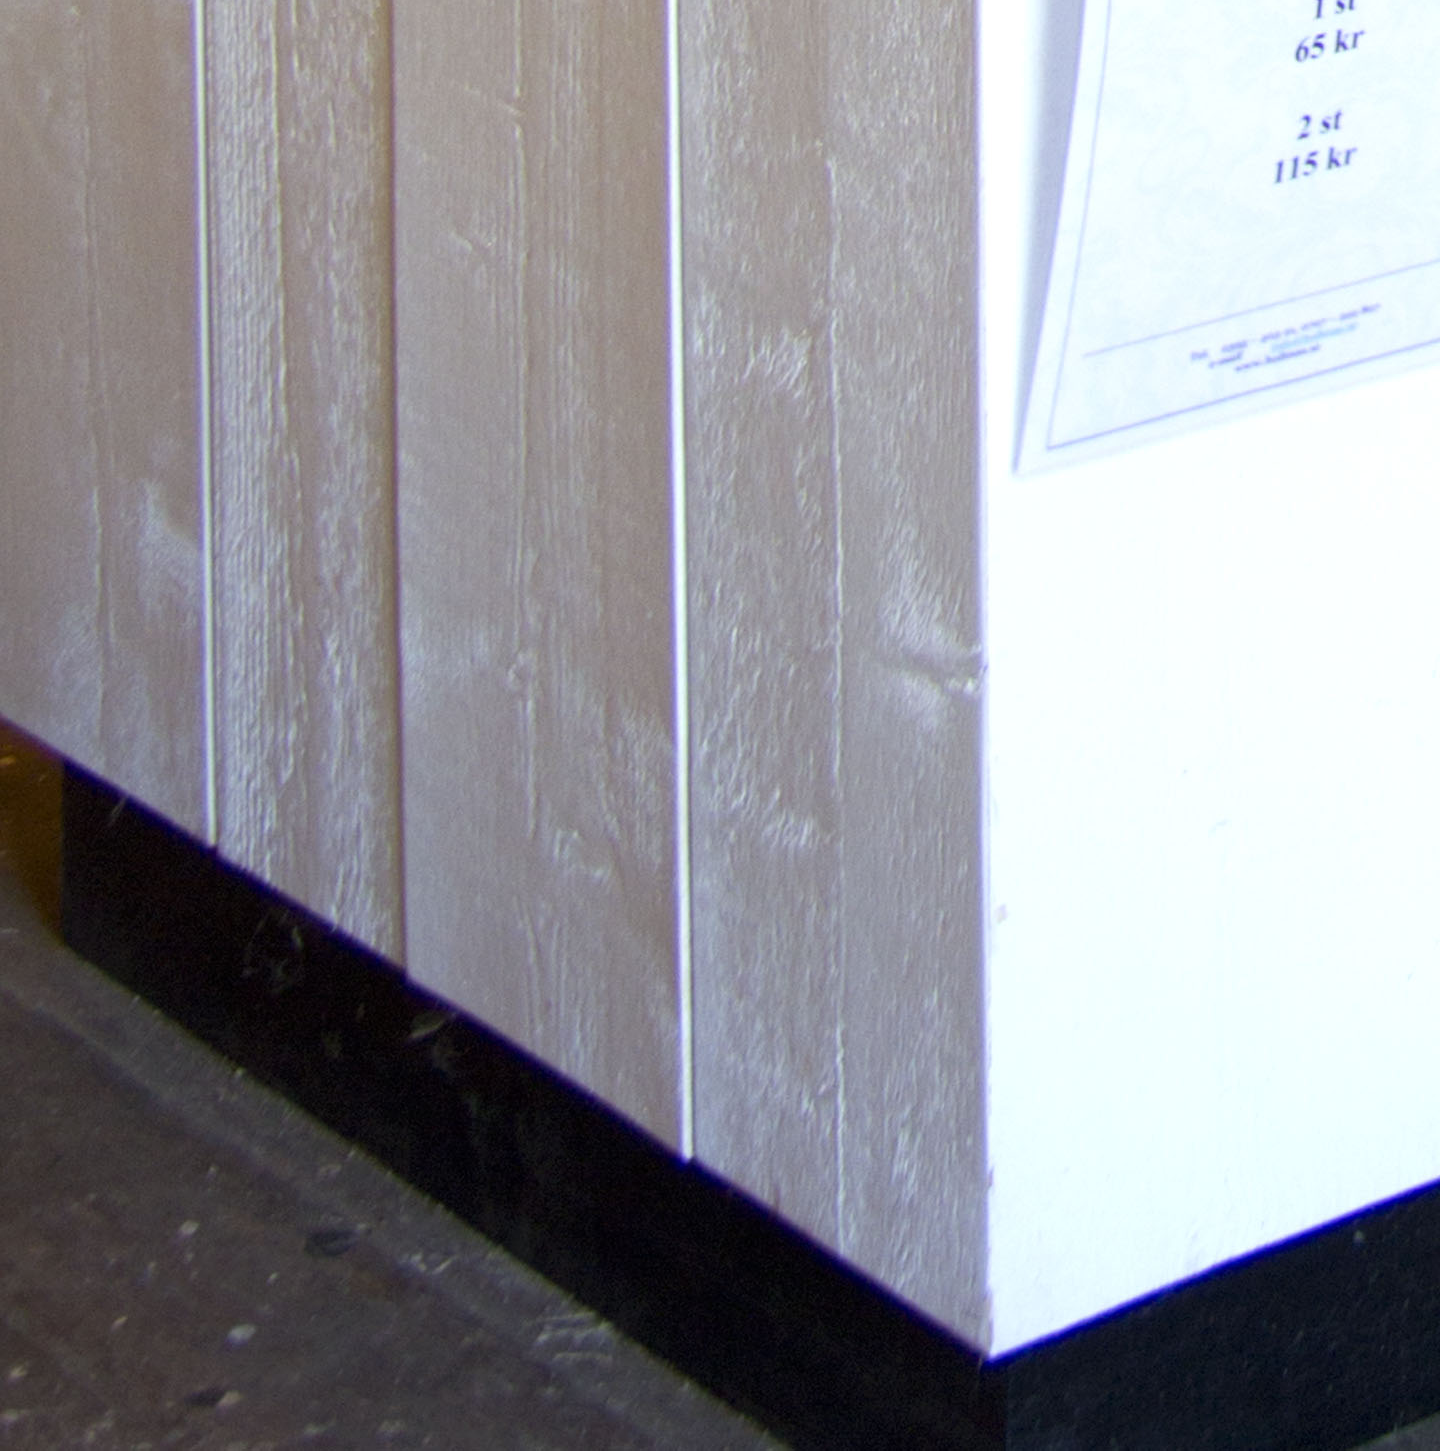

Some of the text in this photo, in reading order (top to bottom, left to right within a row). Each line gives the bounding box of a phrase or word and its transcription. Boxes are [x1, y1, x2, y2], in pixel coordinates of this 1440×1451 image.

[1295, 23, 1365, 66] 65 kr
[1297, 105, 1344, 140] 2 st
[1272, 142, 1358, 186] 115 kr
